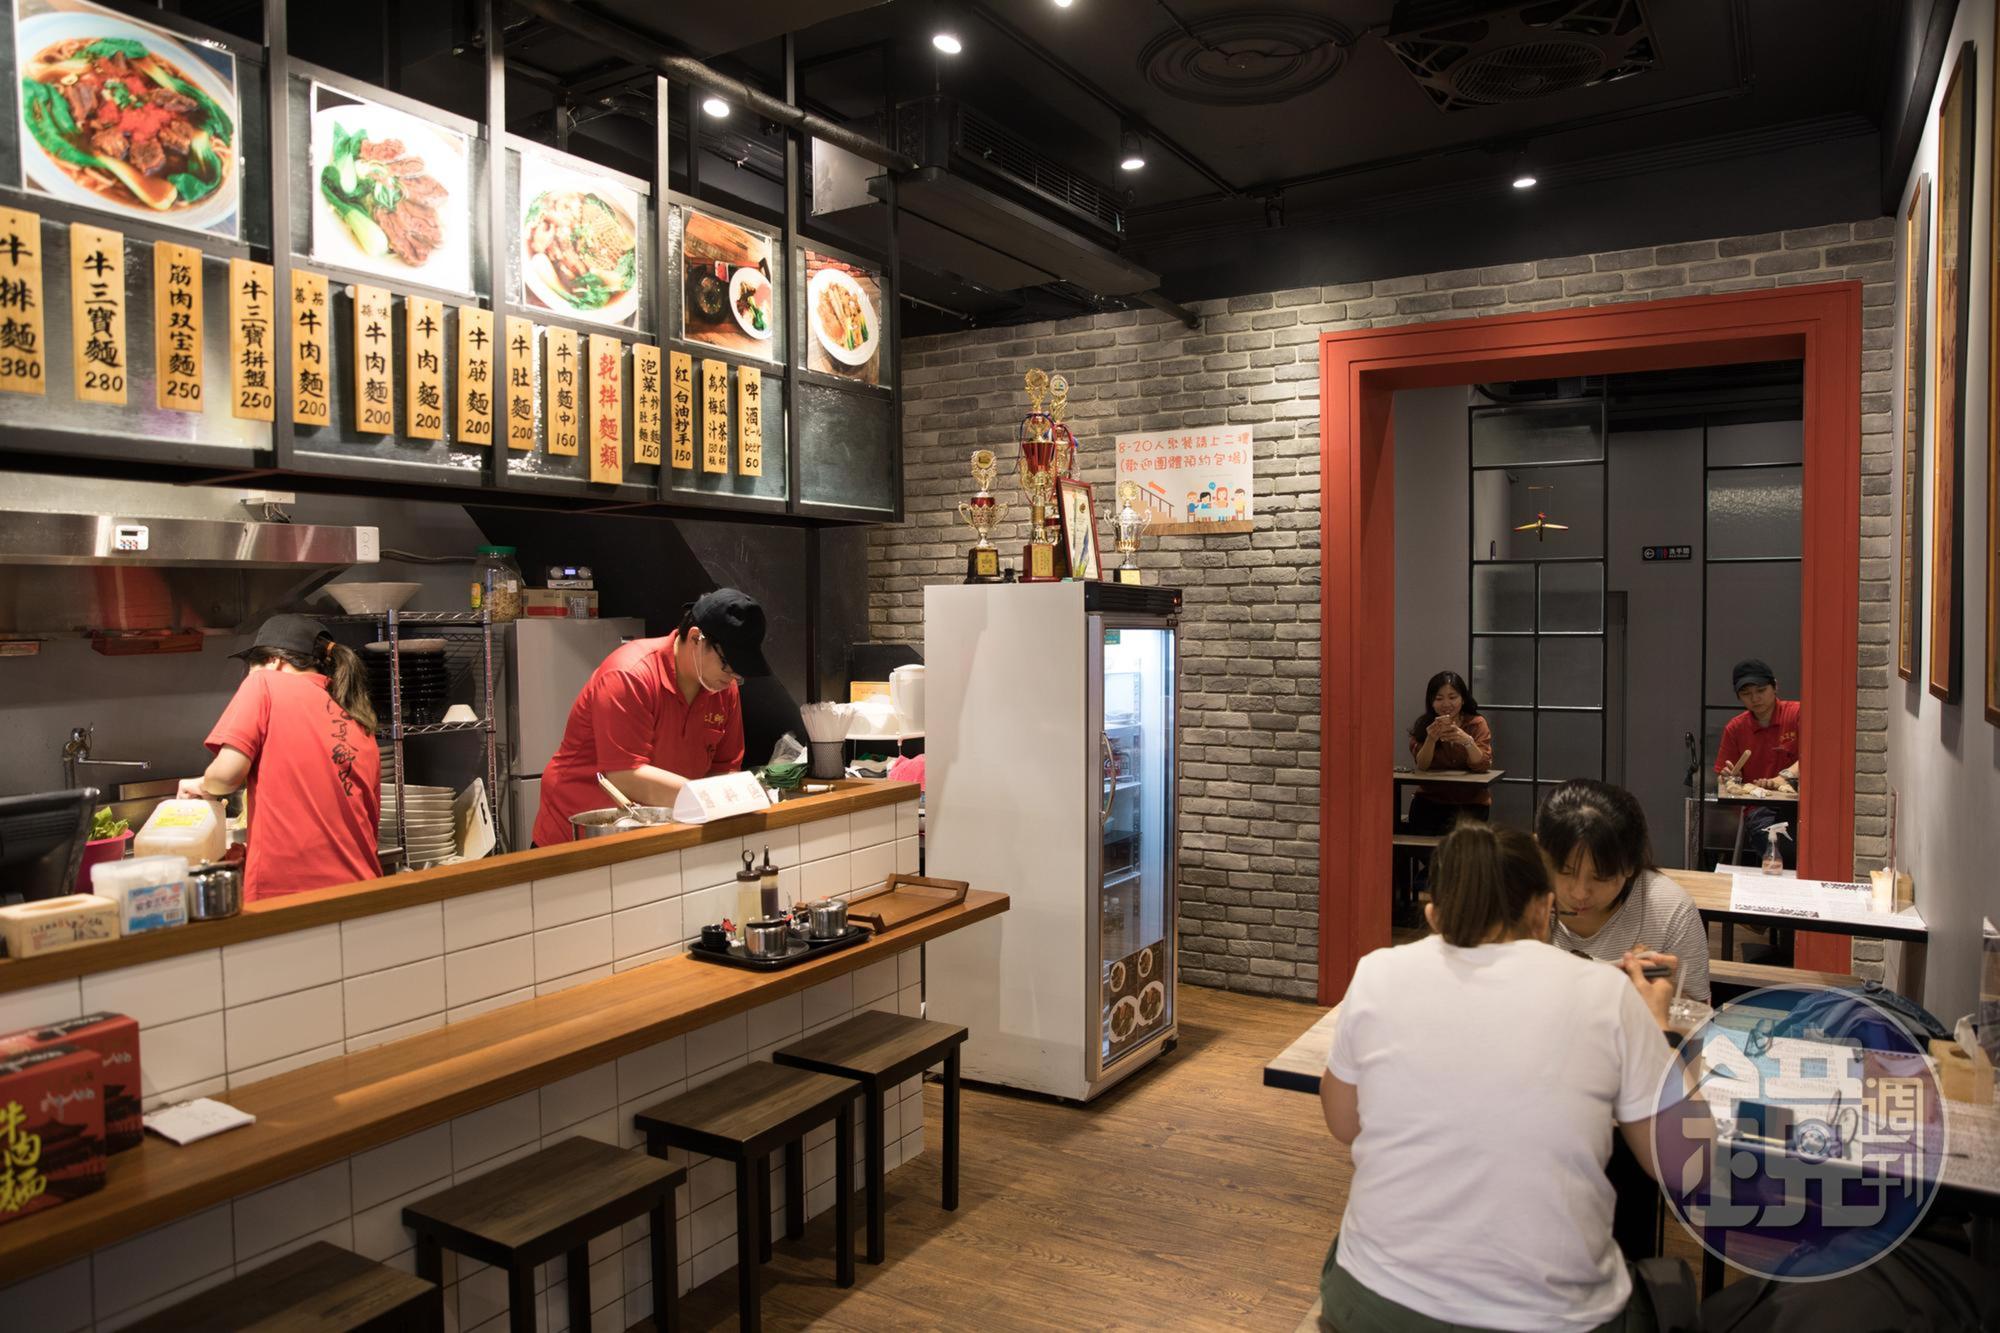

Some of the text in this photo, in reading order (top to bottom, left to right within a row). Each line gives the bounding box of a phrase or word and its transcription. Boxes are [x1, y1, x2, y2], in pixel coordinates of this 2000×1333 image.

[0, 233, 41, 379] 牛排麵 380
[83, 250, 123, 392] 牛三寶麵 280
[167, 380, 200, 400] 250
[240, 391, 272, 409] 250
[299, 309, 326, 417] 牛肉麵 200
[364, 321, 391, 425] 牛肉麵 200
[415, 315, 441, 430] 牛肉麵 200
[465, 326, 490, 434] 牛筋麵 200
[511, 335, 533, 440] 牛肚麵 200
[597, 353, 619, 469] 乾拌麵類
[745, 381, 758, 426] 啤酒
[556, 432, 576, 447] 160
[642, 445, 660, 458] 150
[674, 449, 691, 461] 150
